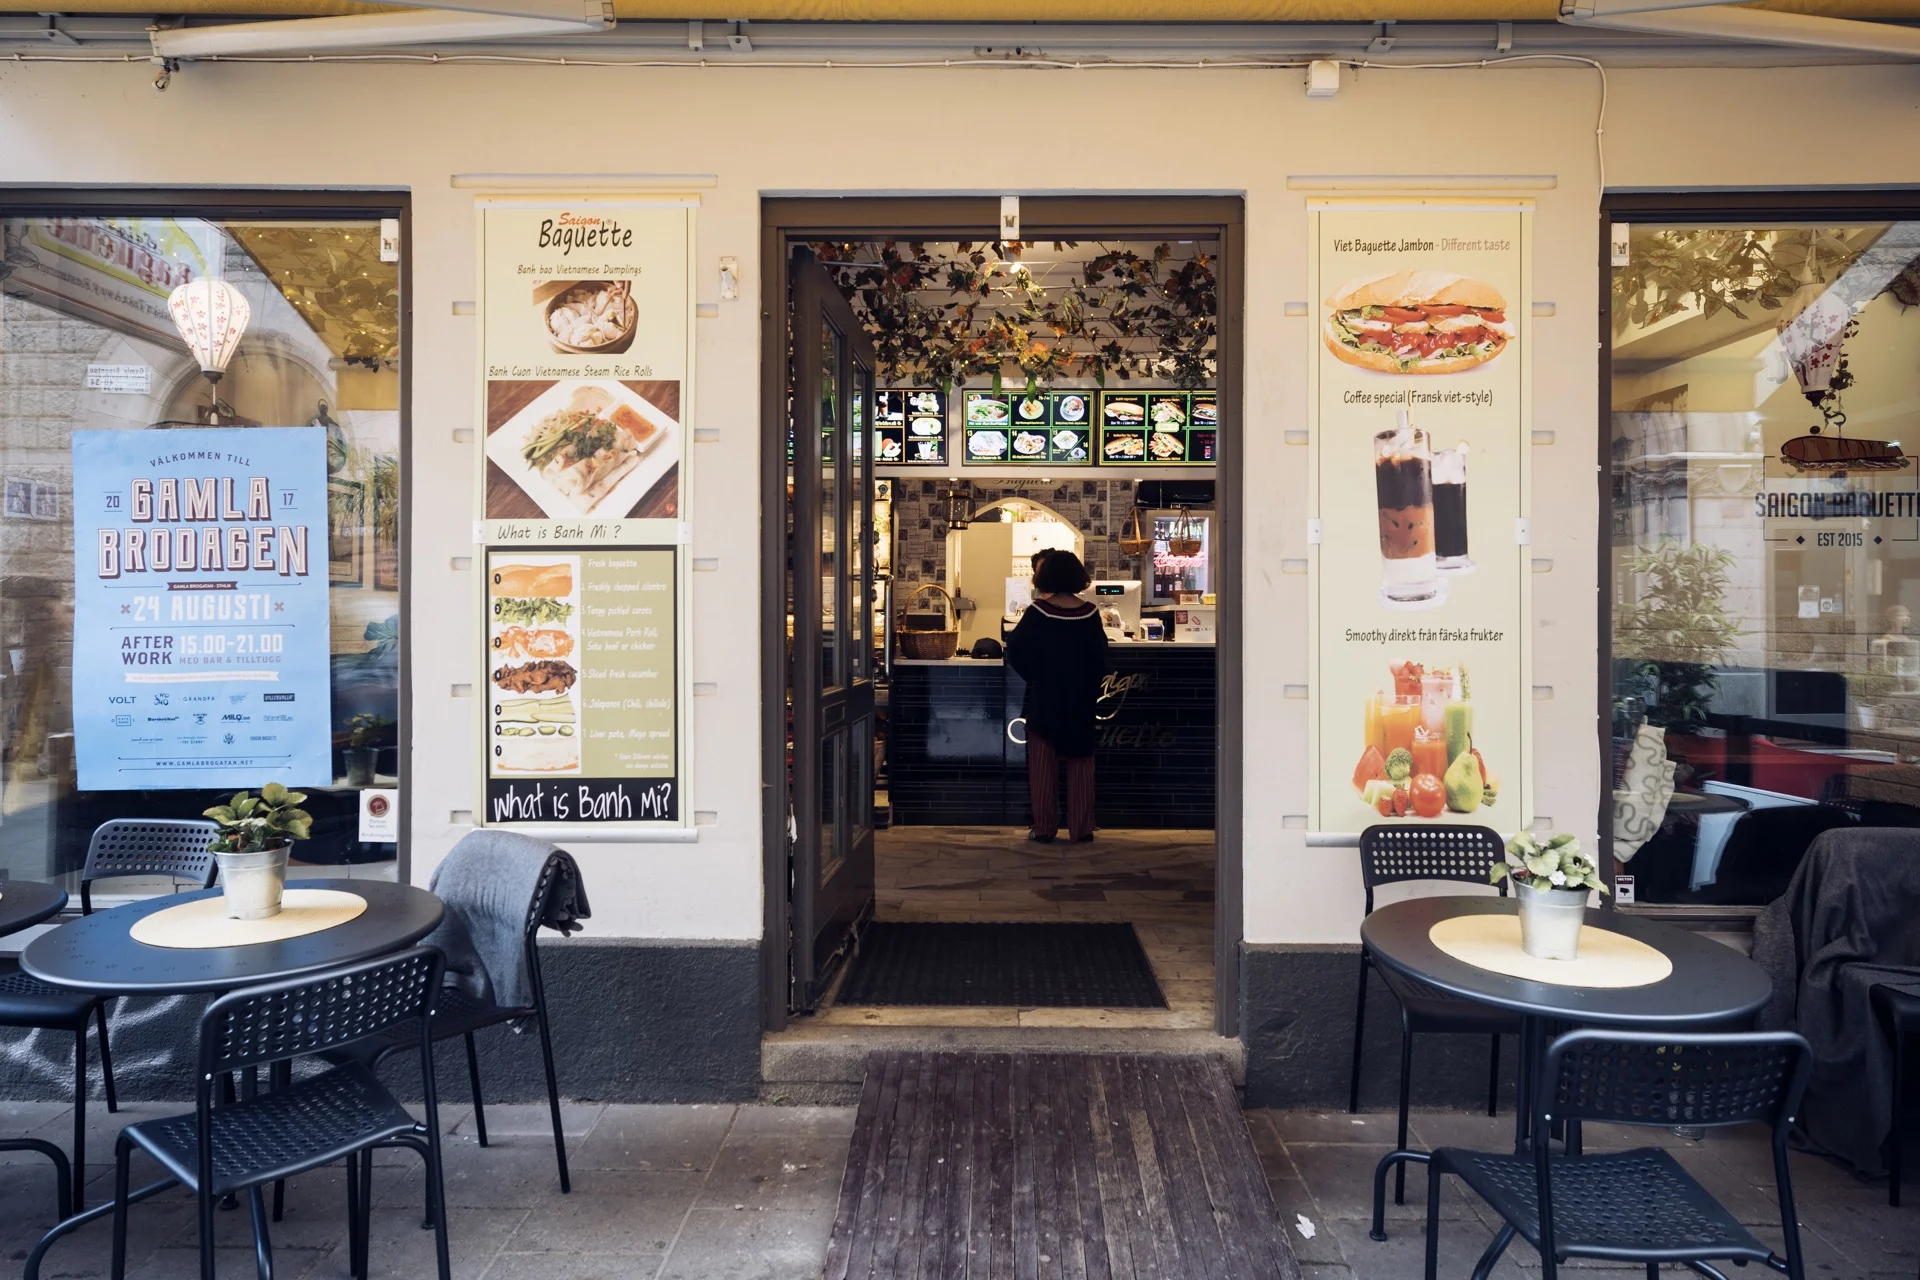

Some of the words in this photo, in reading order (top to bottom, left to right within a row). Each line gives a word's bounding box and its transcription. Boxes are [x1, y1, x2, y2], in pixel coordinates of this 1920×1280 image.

[558, 212, 600, 229] Saigon
[538, 219, 633, 256] Baguette
[1334, 240, 1353, 252] Viet
[1355, 239, 1396, 255] Baguette
[1398, 238, 1434, 252] Jambon
[1442, 238, 1482, 251] Different
[1484, 239, 1510, 250] taste
[517, 264, 535, 274] Banh
[539, 265, 552, 274] bao
[556, 264, 600, 274] Vietnamese
[603, 264, 642, 276] Dumplings
[489, 366, 508, 377] Banh
[512, 366, 531, 376] Cuon
[536, 366, 580, 377] Vietnamese
[584, 365, 610, 377] Steam
[614, 366, 630, 376] Rice
[634, 365, 653, 376] Rolls
[1344, 391, 1372, 404] Coffee
[1373, 390, 1406, 408] special
[1408, 390, 1442, 406] (Fransk
[1444, 390, 1493, 407] viet-style)
[150, 452, 221, 467] VÄLKOMMEN
[227, 454, 250, 467] TILL
[106, 496, 120, 508] 20
[131, 477, 272, 523] GAMLA
[283, 493, 294, 506] 17
[1755, 492, 1825, 518] SAIGON
[498, 525, 531, 540] What
[538, 526, 547, 539] is
[554, 525, 583, 539] Banh
[590, 526, 607, 539] Mi
[614, 525, 622, 538] ?
[1818, 533, 1835, 546] EST
[1838, 533, 1862, 546] 2015
[98, 526, 309, 579] BRODAGEN
[588, 558, 606, 568] Fresh
[608, 558, 637, 570] baguette
[588, 582, 611, 593] Freshly
[134, 596, 160, 622] 24
[171, 594, 270, 621] AUGUSTI
[122, 636, 174, 649] AFTER
[1346, 628, 1387, 644] Smoothy
[1389, 628, 1417, 641] direkt
[1419, 628, 1437, 641] från
[1438, 629, 1469, 641] färska
[1470, 628, 1503, 641] frukter
[180, 634, 284, 654] 15.00-21.00
[122, 652, 172, 665] WORK
[553, 785, 569, 819] is
[578, 784, 632, 819] Banh
[640, 783, 672, 819] Mi?
